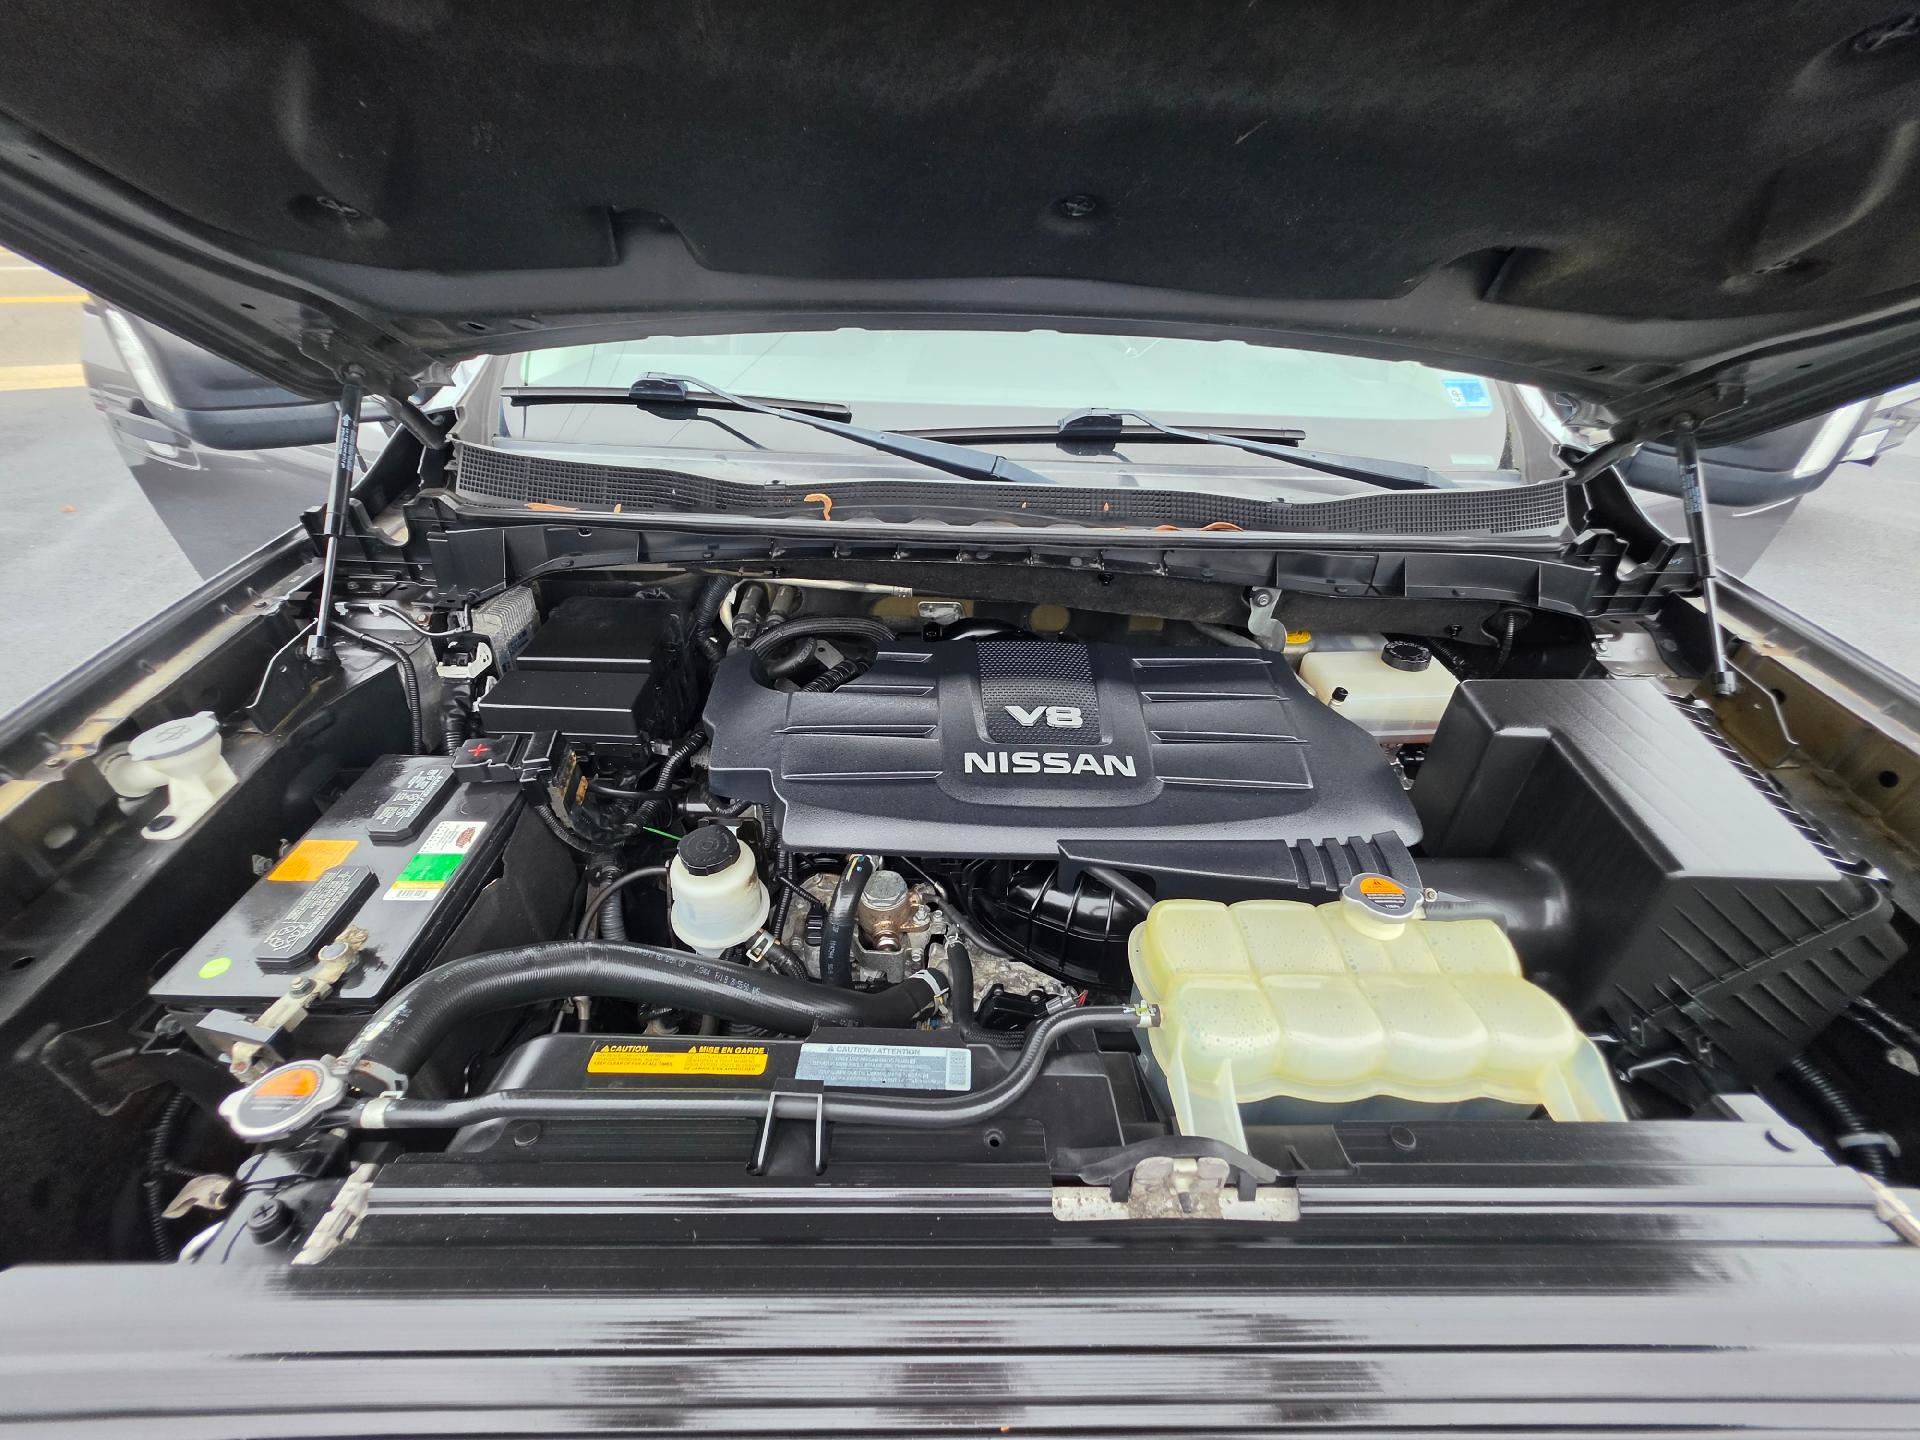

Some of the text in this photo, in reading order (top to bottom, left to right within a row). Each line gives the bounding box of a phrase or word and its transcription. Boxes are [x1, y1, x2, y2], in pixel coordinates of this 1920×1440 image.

[1004, 705, 1085, 729] V8
[963, 751, 1137, 777] NISSAN
[609, 1045, 649, 1053] CAUTION
[698, 1046, 765, 1055] MISE EN GARDE
[836, 1045, 872, 1054] CAUTION
[876, 1047, 921, 1056] ATTENTION
